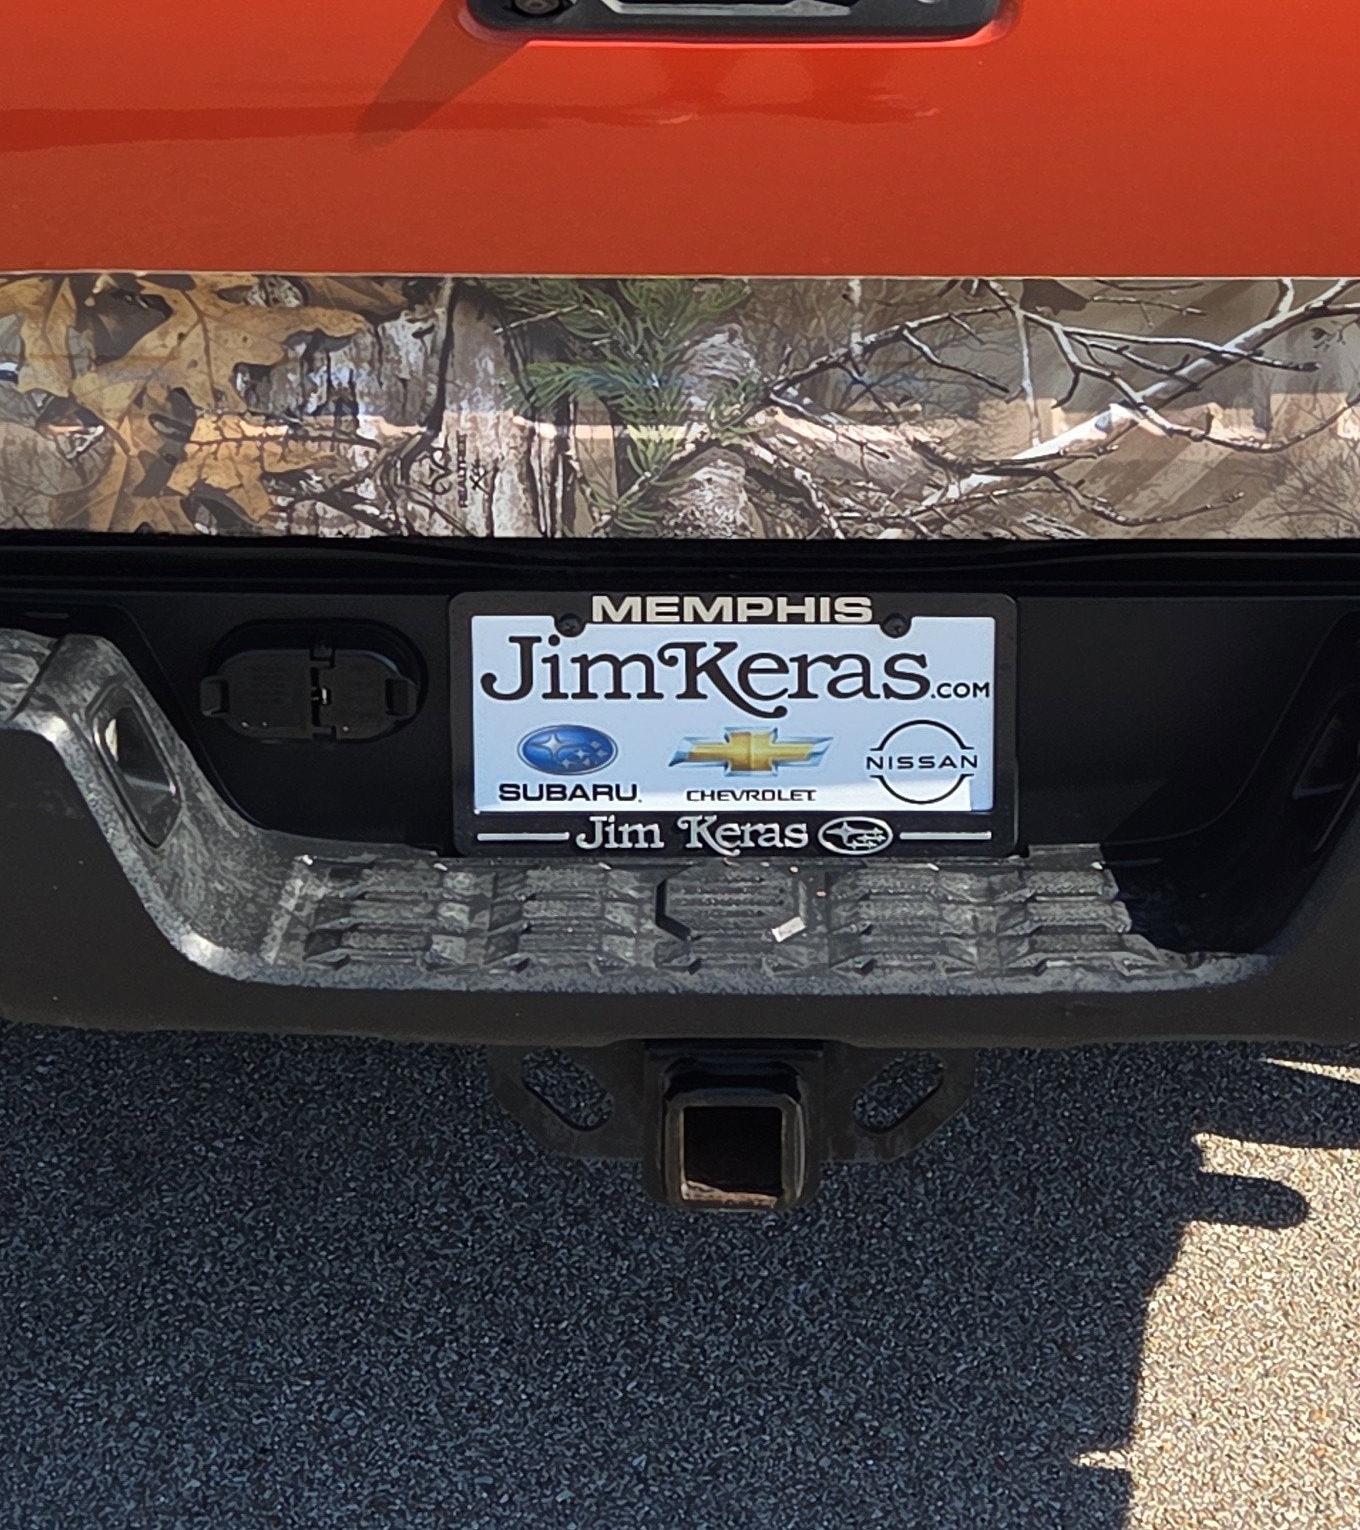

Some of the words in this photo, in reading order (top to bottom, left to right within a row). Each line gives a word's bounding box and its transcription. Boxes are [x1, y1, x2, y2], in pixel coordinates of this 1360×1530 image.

[591, 594, 873, 624] MEMPHIS
[865, 754, 978, 771] NISSAN
[498, 782, 638, 803] SUBARU
[685, 788, 817, 803] CHEVROLET
[575, 815, 665, 851] Jim
[677, 815, 809, 857] Keras
